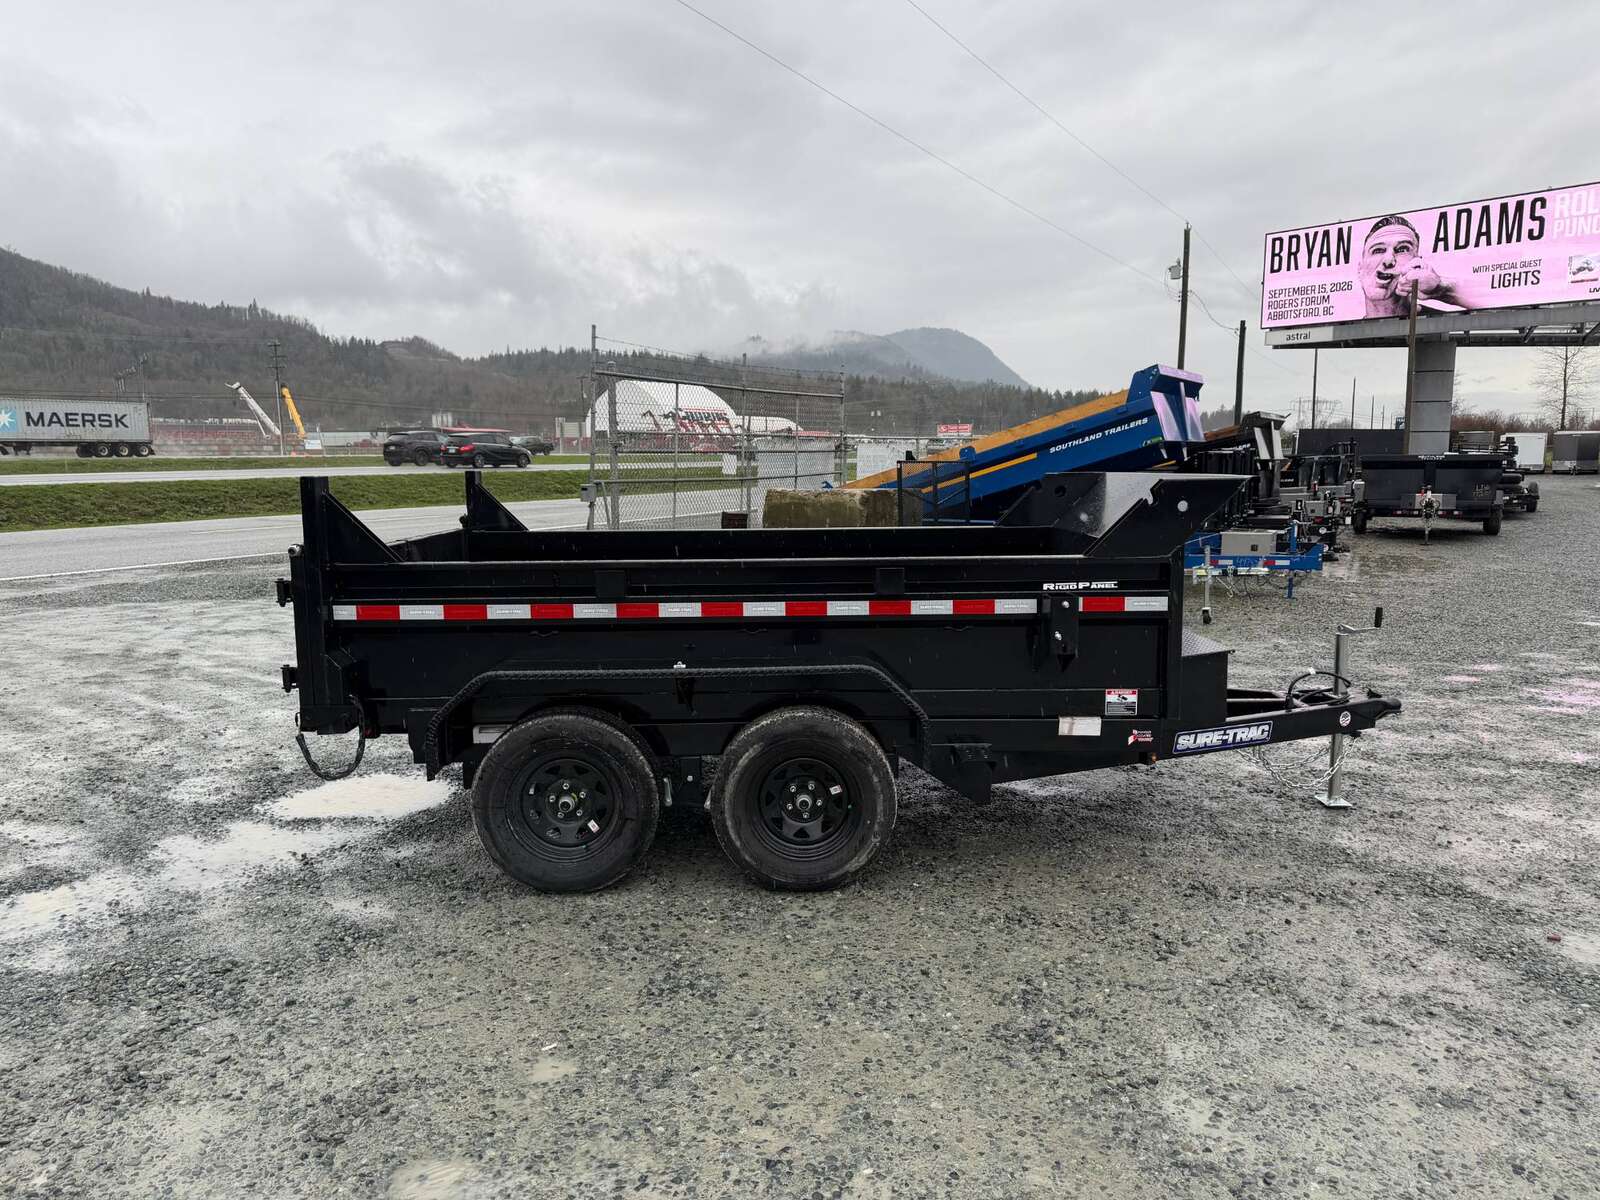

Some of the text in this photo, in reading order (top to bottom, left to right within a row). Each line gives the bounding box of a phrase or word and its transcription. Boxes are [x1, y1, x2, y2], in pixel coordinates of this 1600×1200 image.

[1270, 196, 1547, 274] BRYAN ADAMS
[1472, 258, 1543, 274] WITH SPECIAL GUEST
[1490, 269, 1542, 290] LIGHTS
[1268, 280, 1354, 300] SEPTEMBER 15, 2026
[1267, 294, 1331, 311] ROGERS FORUM
[1267, 305, 1335, 321] ABBOTSFORD, BC
[1285, 331, 1312, 341] astral
[25, 411, 130, 429] MAERSK
[1049, 417, 1149, 454] SOUTHLAND TRAILERS
[1176, 725, 1270, 750] SURE-TRAC
